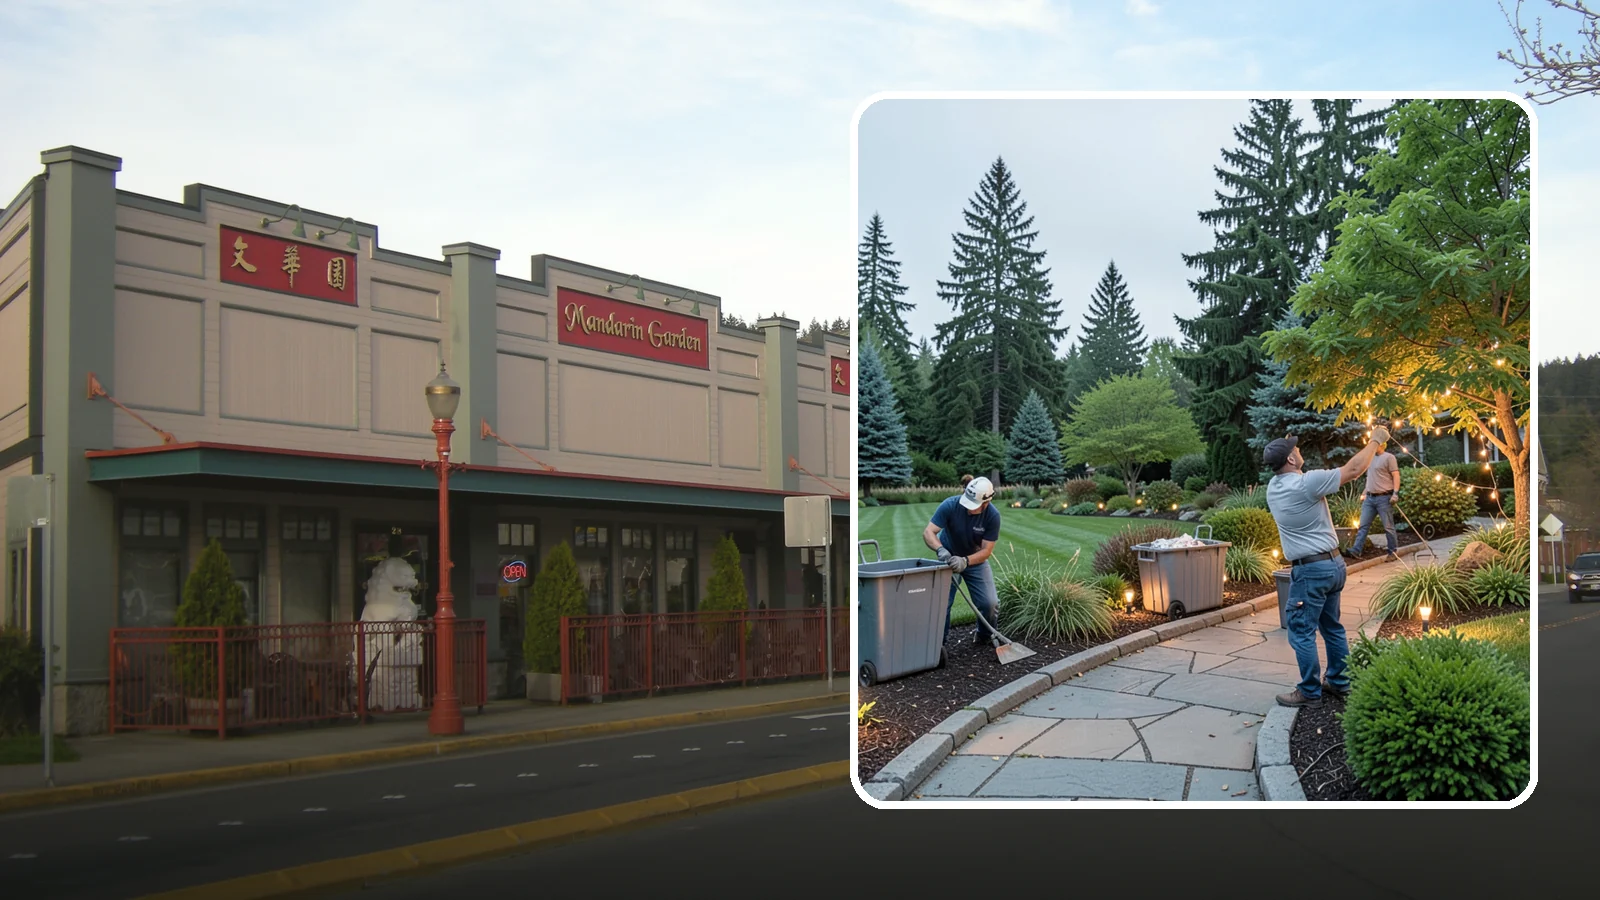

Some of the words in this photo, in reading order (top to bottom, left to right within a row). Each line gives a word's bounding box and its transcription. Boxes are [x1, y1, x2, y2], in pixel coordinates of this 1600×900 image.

[231, 235, 346, 291] 文華園
[565, 302, 644, 341] Mandarin
[648, 320, 702, 352] Garden
[503, 565, 527, 578] OPEN
